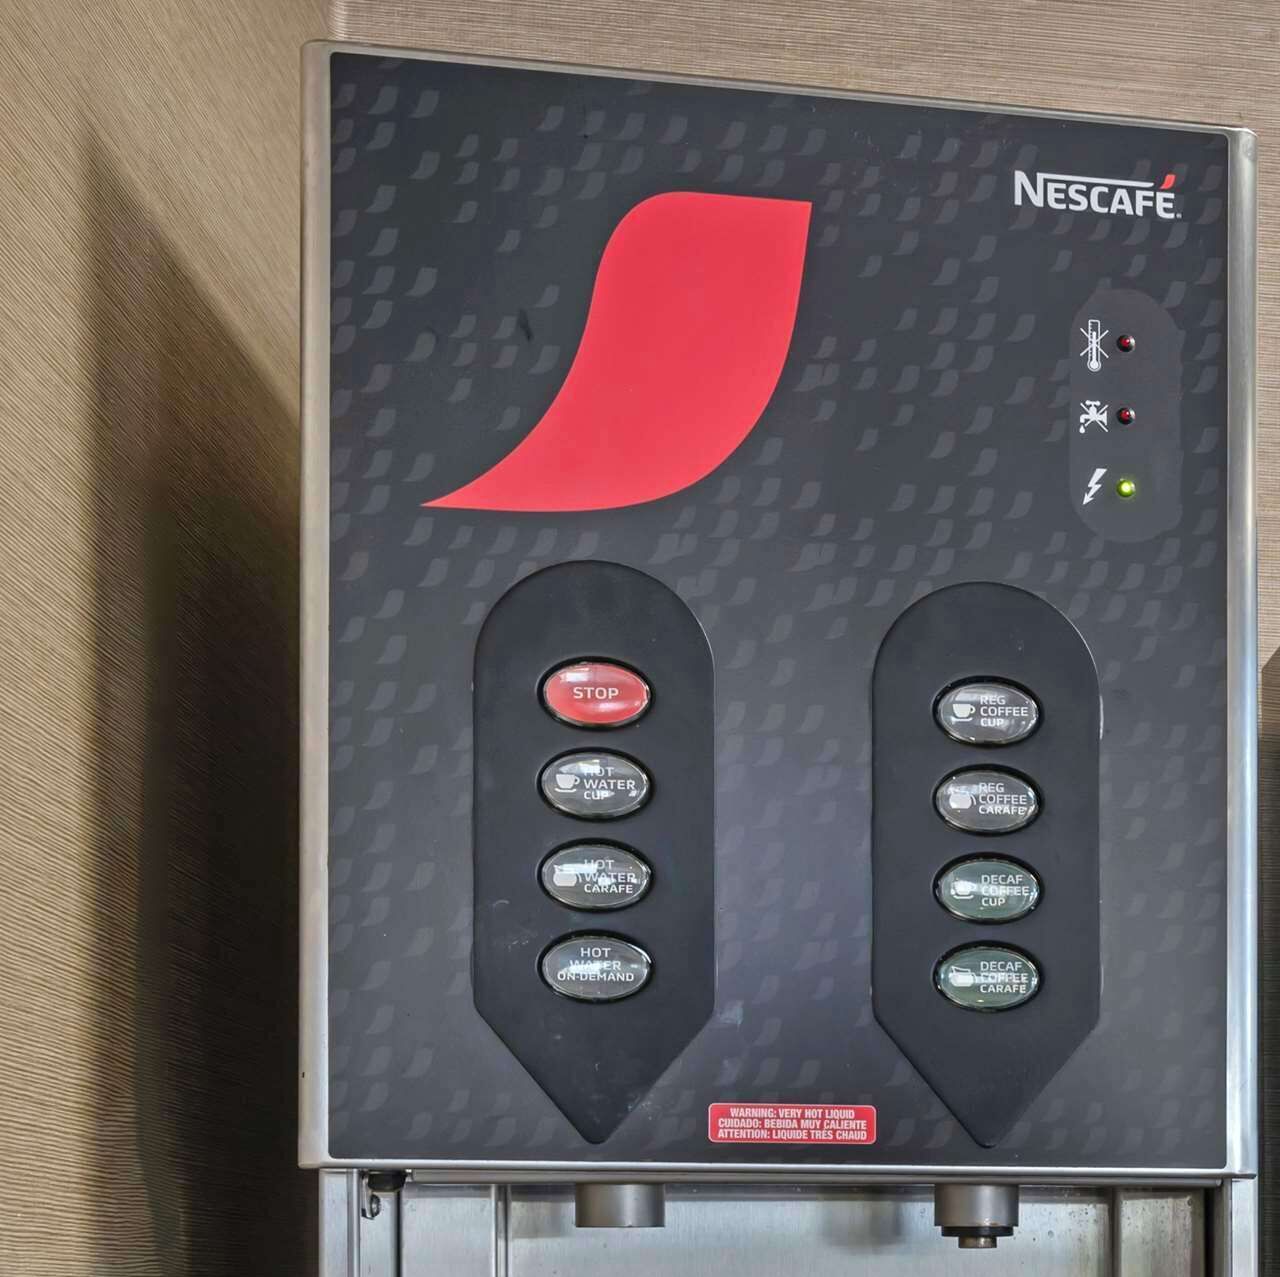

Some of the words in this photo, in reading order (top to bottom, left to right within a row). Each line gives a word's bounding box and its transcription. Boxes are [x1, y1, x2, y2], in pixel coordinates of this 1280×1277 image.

[1014, 170, 1175, 219] NESCAFÉ
[572, 686, 619, 700] STOP
[980, 695, 1006, 705] REG
[980, 706, 1028, 717] COFFEE
[980, 716, 1004, 727] CUP
[583, 766, 614, 777] HOT
[583, 778, 636, 791] WATER
[979, 782, 1004, 793] REG
[583, 790, 609, 800] CUP
[979, 794, 1027, 805] COFFEE
[978, 805, 1025, 816] CARAFE
[584, 859, 614, 870] HOT
[584, 872, 636, 884] WATER
[981, 874, 1023, 885] DECAF
[583, 883, 634, 894] CARAFE
[981, 885, 1030, 896] COFFEE
[981, 896, 1006, 906] CUP
[580, 947, 610, 958] HOT
[569, 960, 622, 971] WATER
[980, 961, 1022, 971] DECAF
[557, 971, 635, 982] ON-DEMAND
[980, 972, 1028, 983] COFFEE
[979, 983, 1026, 993] CARAFE
[730, 1108, 776, 1118] WARNING:
[778, 1108, 801, 1118] VERY
[804, 1109, 822, 1118] HOT
[825, 1109, 855, 1119] LIQUID
[718, 1118, 762, 1128] CUIDADO:
[764, 1119, 798, 1128] BEBIDA
[800, 1120, 820, 1129] MUY
[823, 1120, 867, 1130] CALIENTE
[717, 1129, 770, 1139] ATTENTION:
[772, 1130, 808, 1140] LIQUIDE
[835, 1130, 867, 1140] CHAUD
